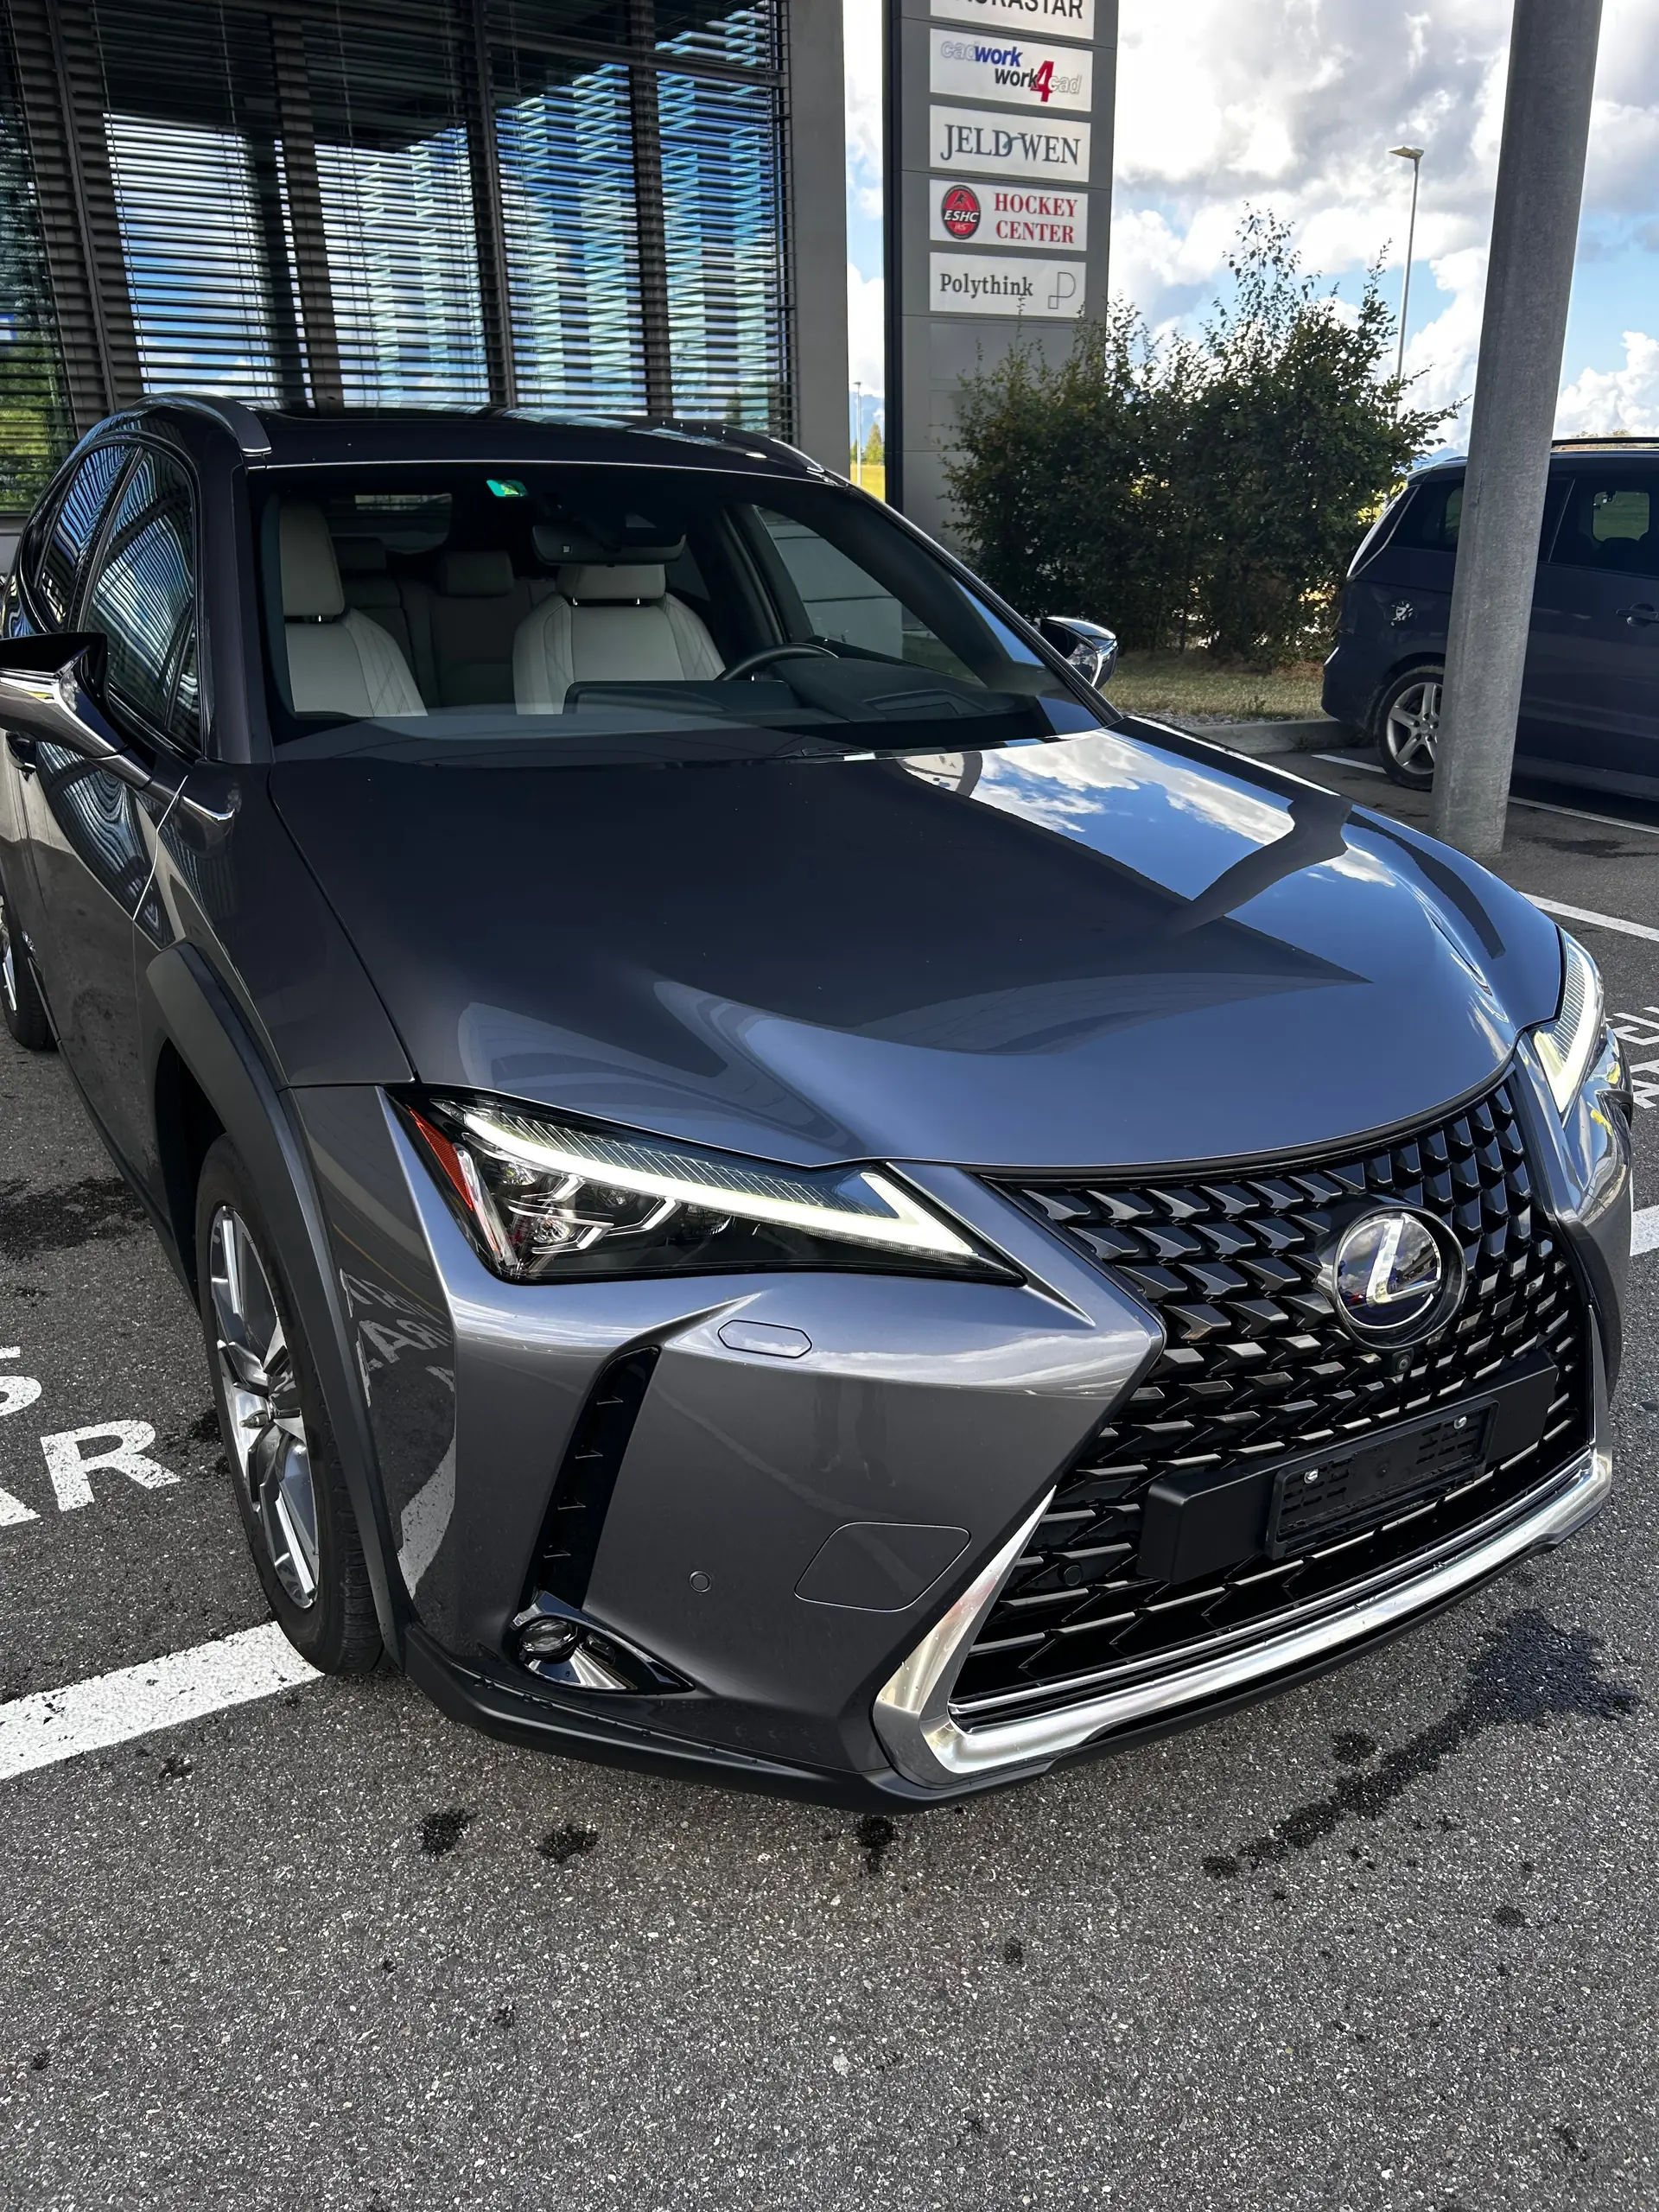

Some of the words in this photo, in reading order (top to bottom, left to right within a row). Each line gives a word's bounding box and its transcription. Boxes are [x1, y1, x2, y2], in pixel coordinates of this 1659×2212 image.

[944, 210, 980, 223] ESHC
[994, 192, 1078, 218] HOCKEY
[995, 219, 1074, 244] CENTER
[939, 272, 1033, 299] Polythink
